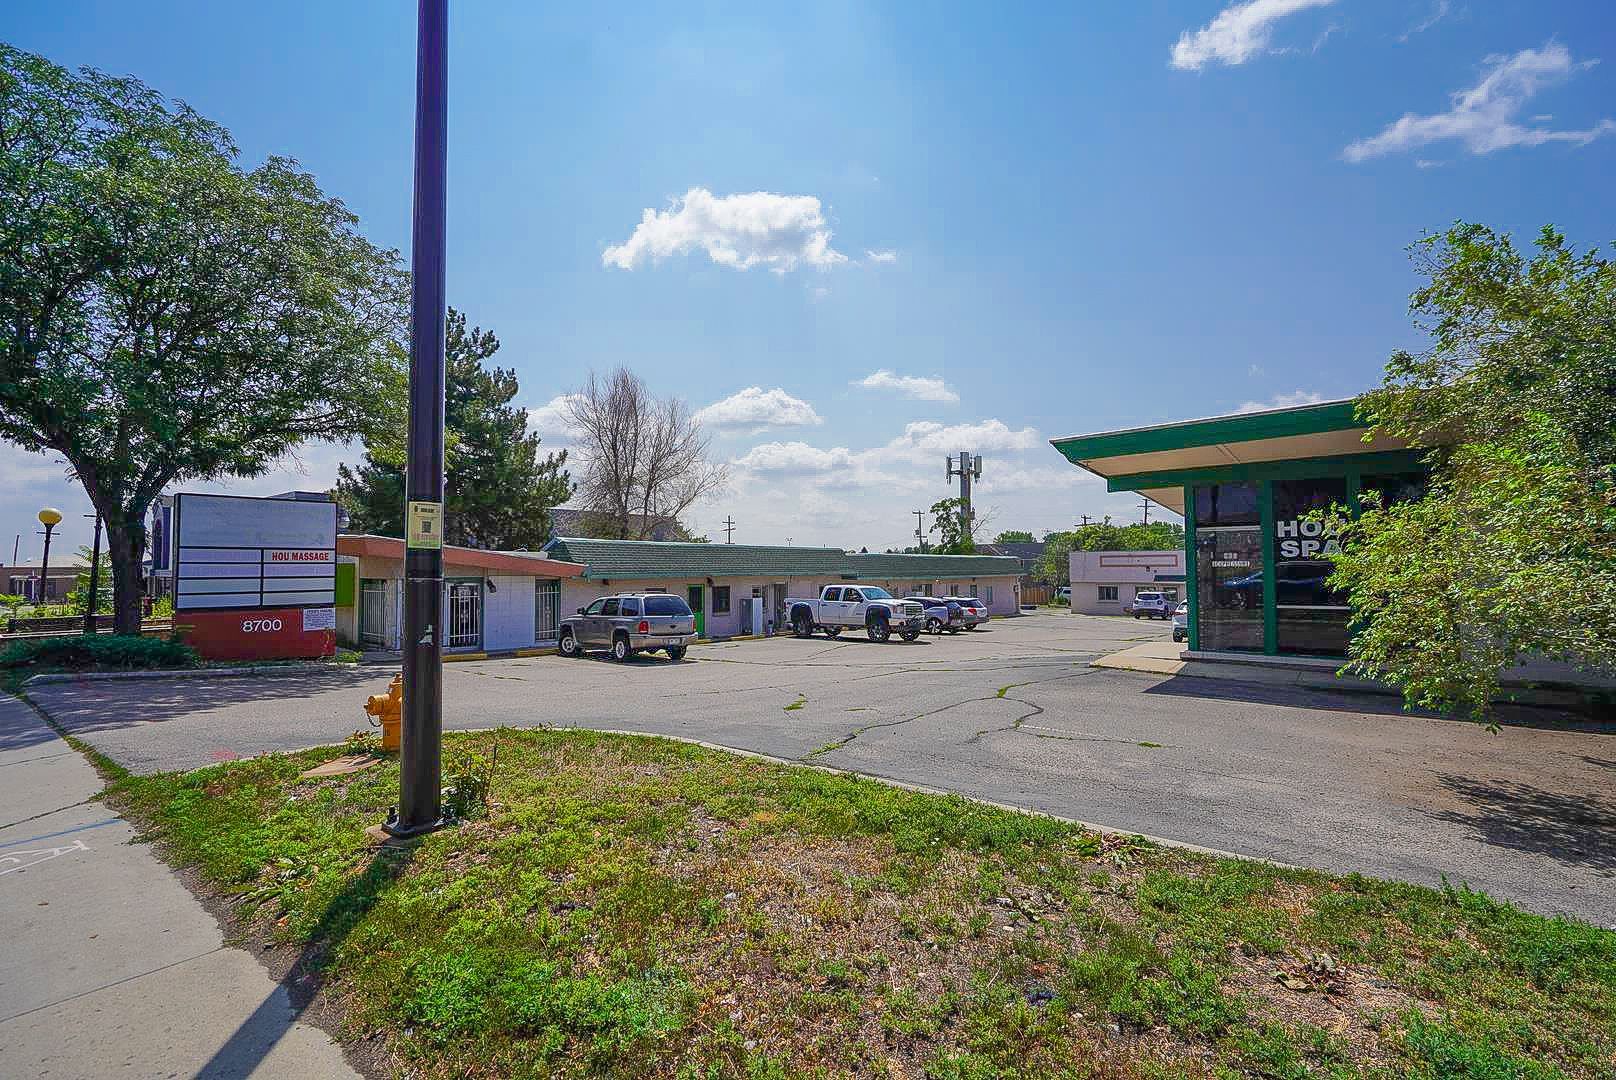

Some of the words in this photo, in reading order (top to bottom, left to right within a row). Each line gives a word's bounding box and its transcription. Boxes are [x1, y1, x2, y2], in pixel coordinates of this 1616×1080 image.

[1280, 539, 1343, 557] SPA
[272, 551, 289, 561] HOU
[291, 551, 329, 561] MASSAGE
[242, 618, 282, 632] 8700
